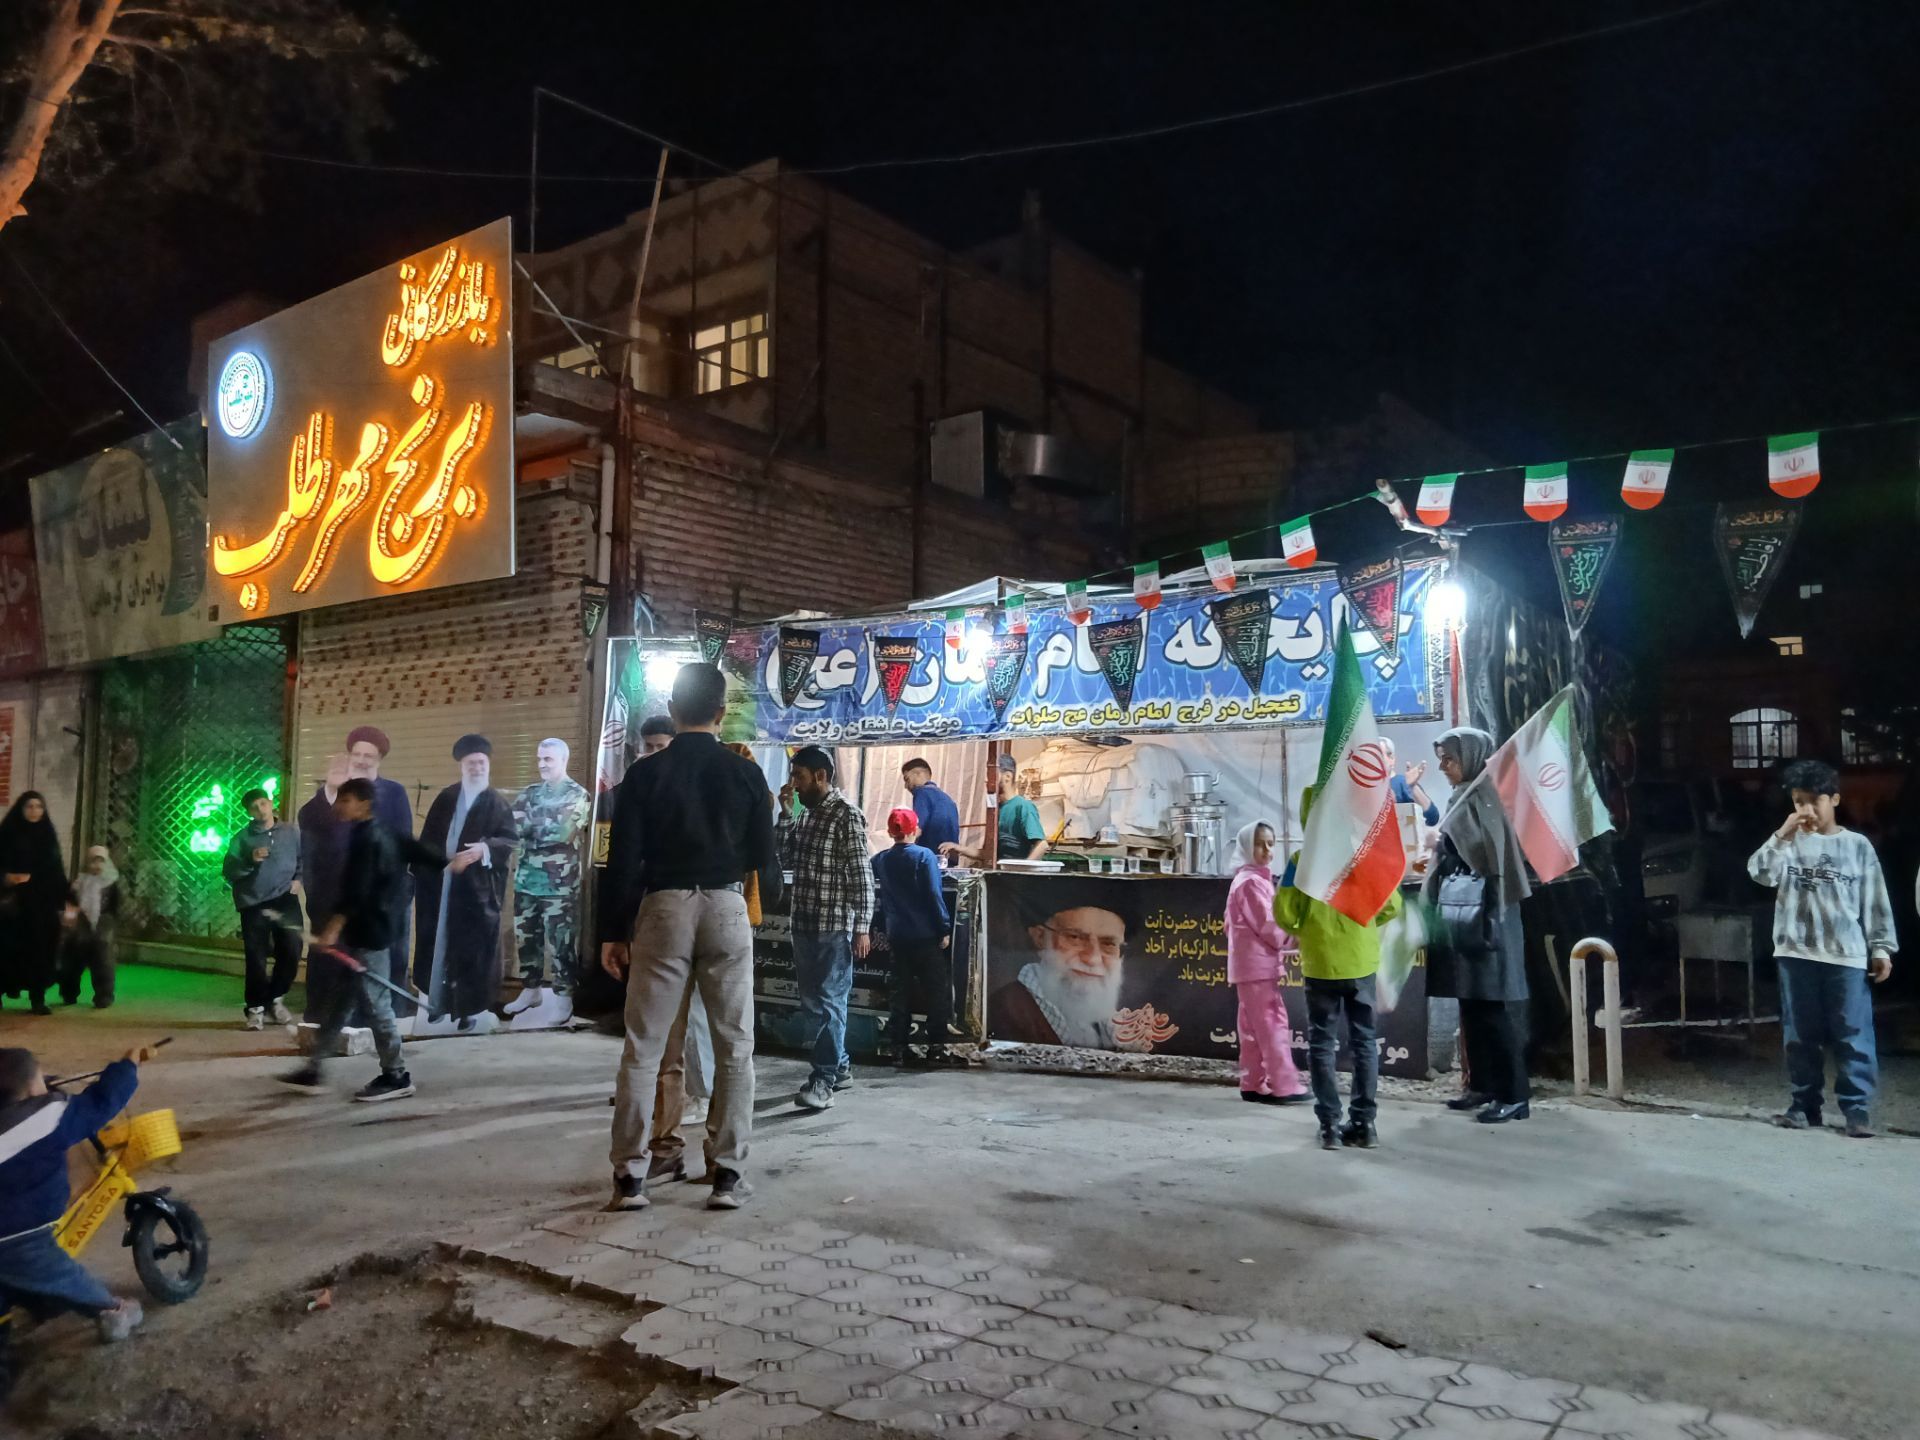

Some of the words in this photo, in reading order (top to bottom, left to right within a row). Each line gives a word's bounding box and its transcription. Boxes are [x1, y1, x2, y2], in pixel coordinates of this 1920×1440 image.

[382, 246, 488, 366] بازرگانی
[369, 373, 482, 585] برنج
[1011, 705, 1060, 728] صلوات
[1063, 708, 1087, 726] عج
[1133, 702, 1171, 725] امام
[1177, 699, 1213, 723] فرج
[1215, 701, 1240, 722] در
[1243, 695, 1300, 720] تعجیل
[794, 718, 841, 740] ولایت
[845, 716, 906, 739] عاشقان
[909, 713, 961, 735] موکب
[1144, 910, 1164, 933] آیت
[1165, 914, 1198, 935] حضرت
[1145, 935, 1165, 954] آحاد
[1168, 942, 1178, 959] بر
[1195, 966, 1225, 987] تعزیت
[68, 1186, 119, 1249] SANTOSA
